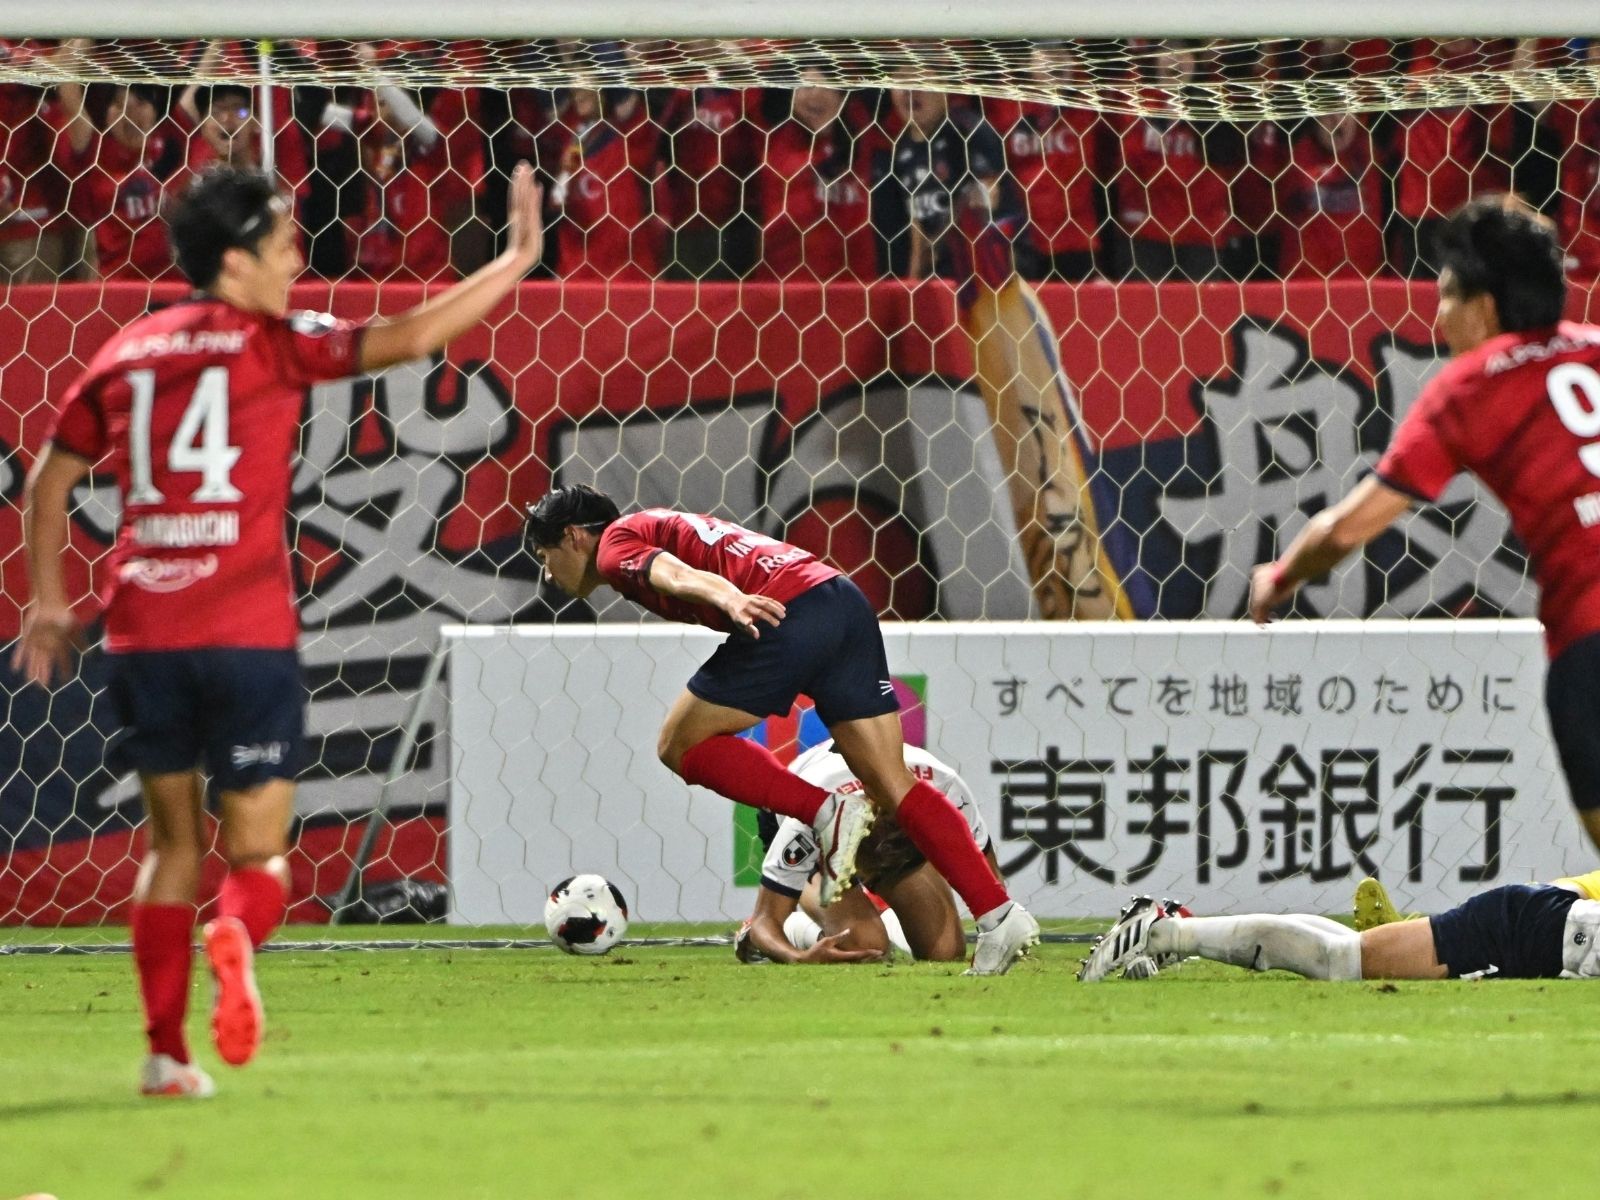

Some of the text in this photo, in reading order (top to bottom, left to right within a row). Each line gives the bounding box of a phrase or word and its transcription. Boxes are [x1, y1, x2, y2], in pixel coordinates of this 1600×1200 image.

[125, 366, 245, 506] 14
[991, 673, 1518, 716] すべてを地域のために
[990, 743, 1517, 886] 東邦銀行
